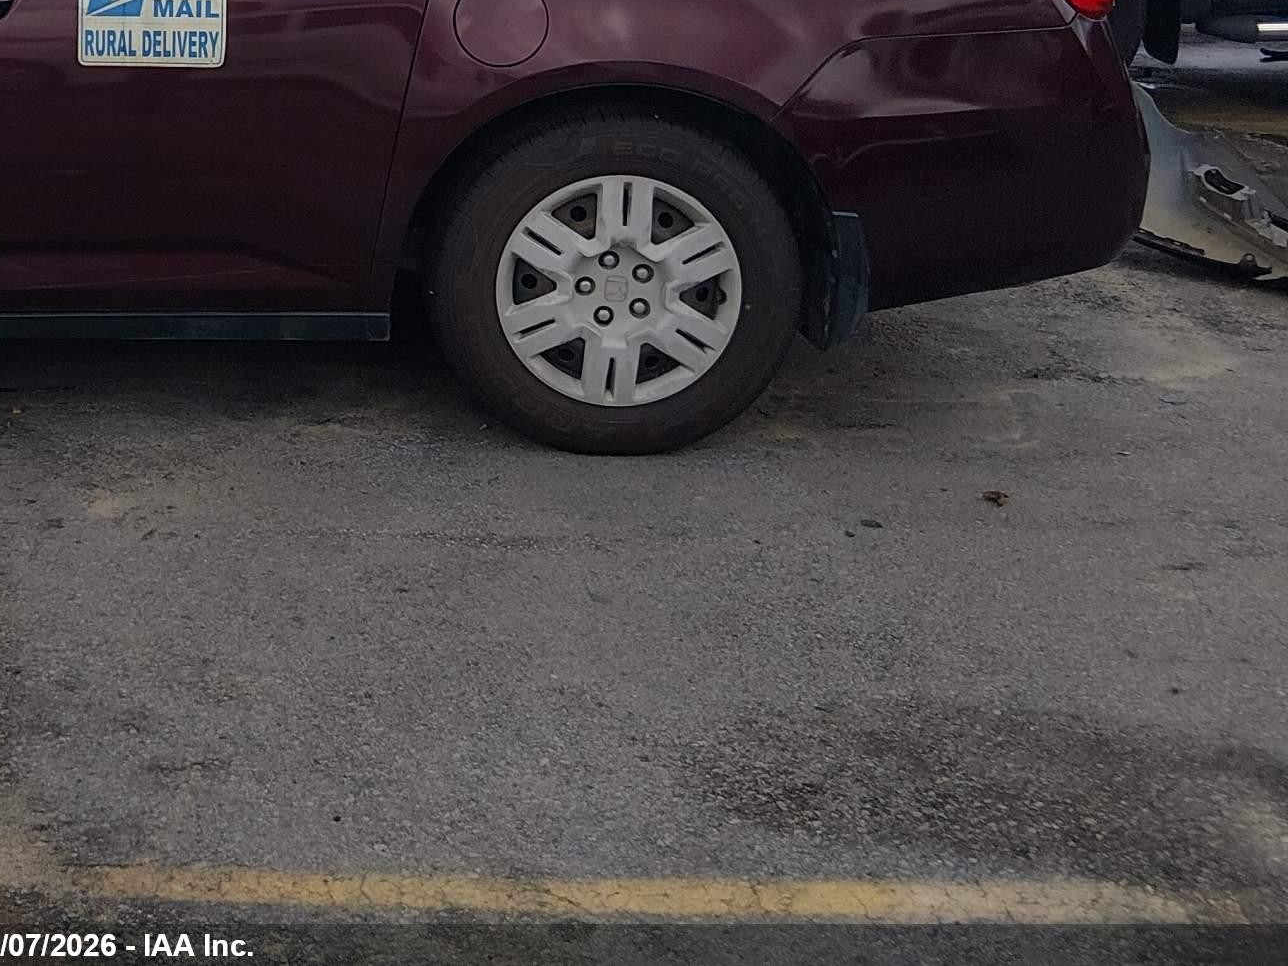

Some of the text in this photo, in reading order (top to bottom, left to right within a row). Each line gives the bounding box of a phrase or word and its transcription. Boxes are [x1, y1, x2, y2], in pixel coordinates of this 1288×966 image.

[153, 0, 220, 18] MAIL
[85, 30, 220, 59] RURAL DELIVERY
